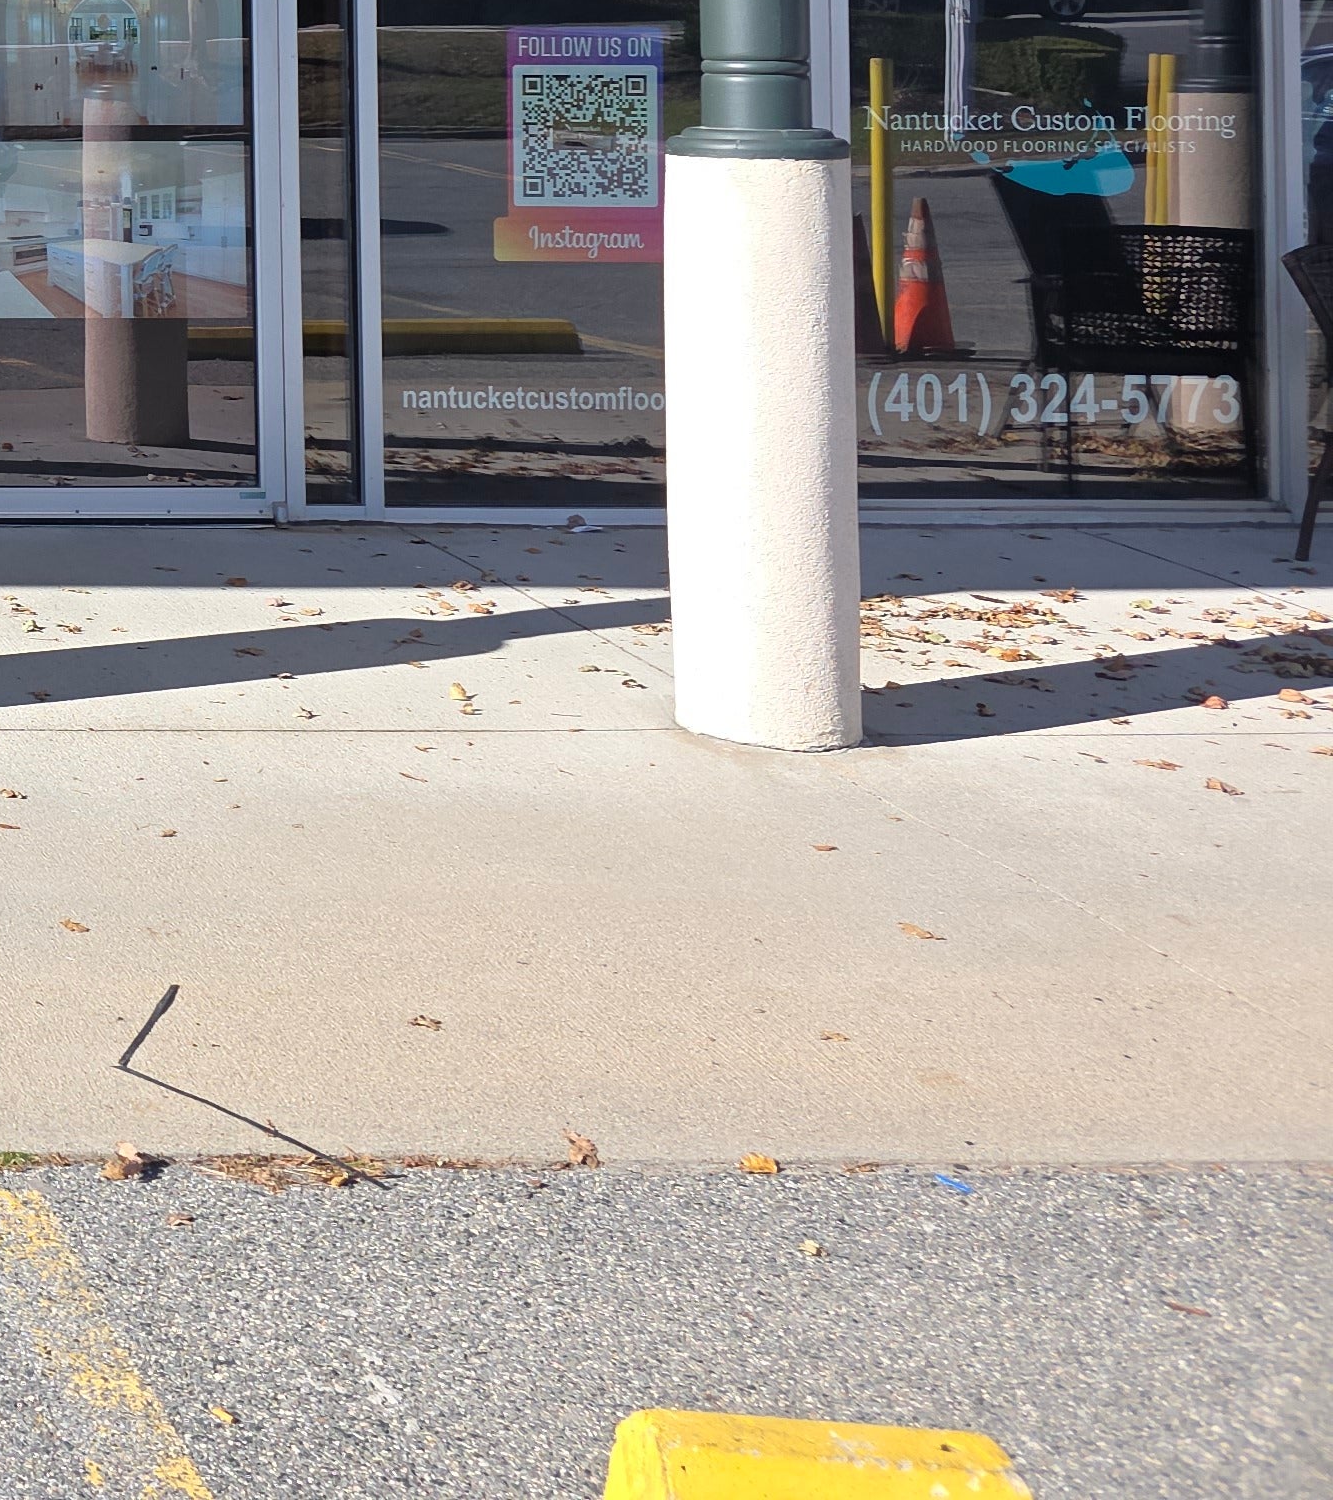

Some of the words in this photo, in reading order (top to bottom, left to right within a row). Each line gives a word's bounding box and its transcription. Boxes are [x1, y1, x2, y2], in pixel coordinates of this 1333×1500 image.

[518, 36, 592, 57] FOLLOW
[598, 37, 622, 57] US
[627, 37, 652, 57] ON
[864, 104, 1003, 132] Nantucket
[1010, 104, 1115, 132] Custom
[1125, 103, 1237, 140] Flooring
[901, 140, 999, 153] HARDWOOD
[1003, 140, 1089, 153] FLOORING
[1094, 139, 1196, 153] SPECIALISTS
[528, 225, 645, 259] Instagram
[402, 385, 666, 410] nantucketcustomfloo
[868, 372, 993, 434] (401)
[1010, 373, 1241, 426] 324-5773
